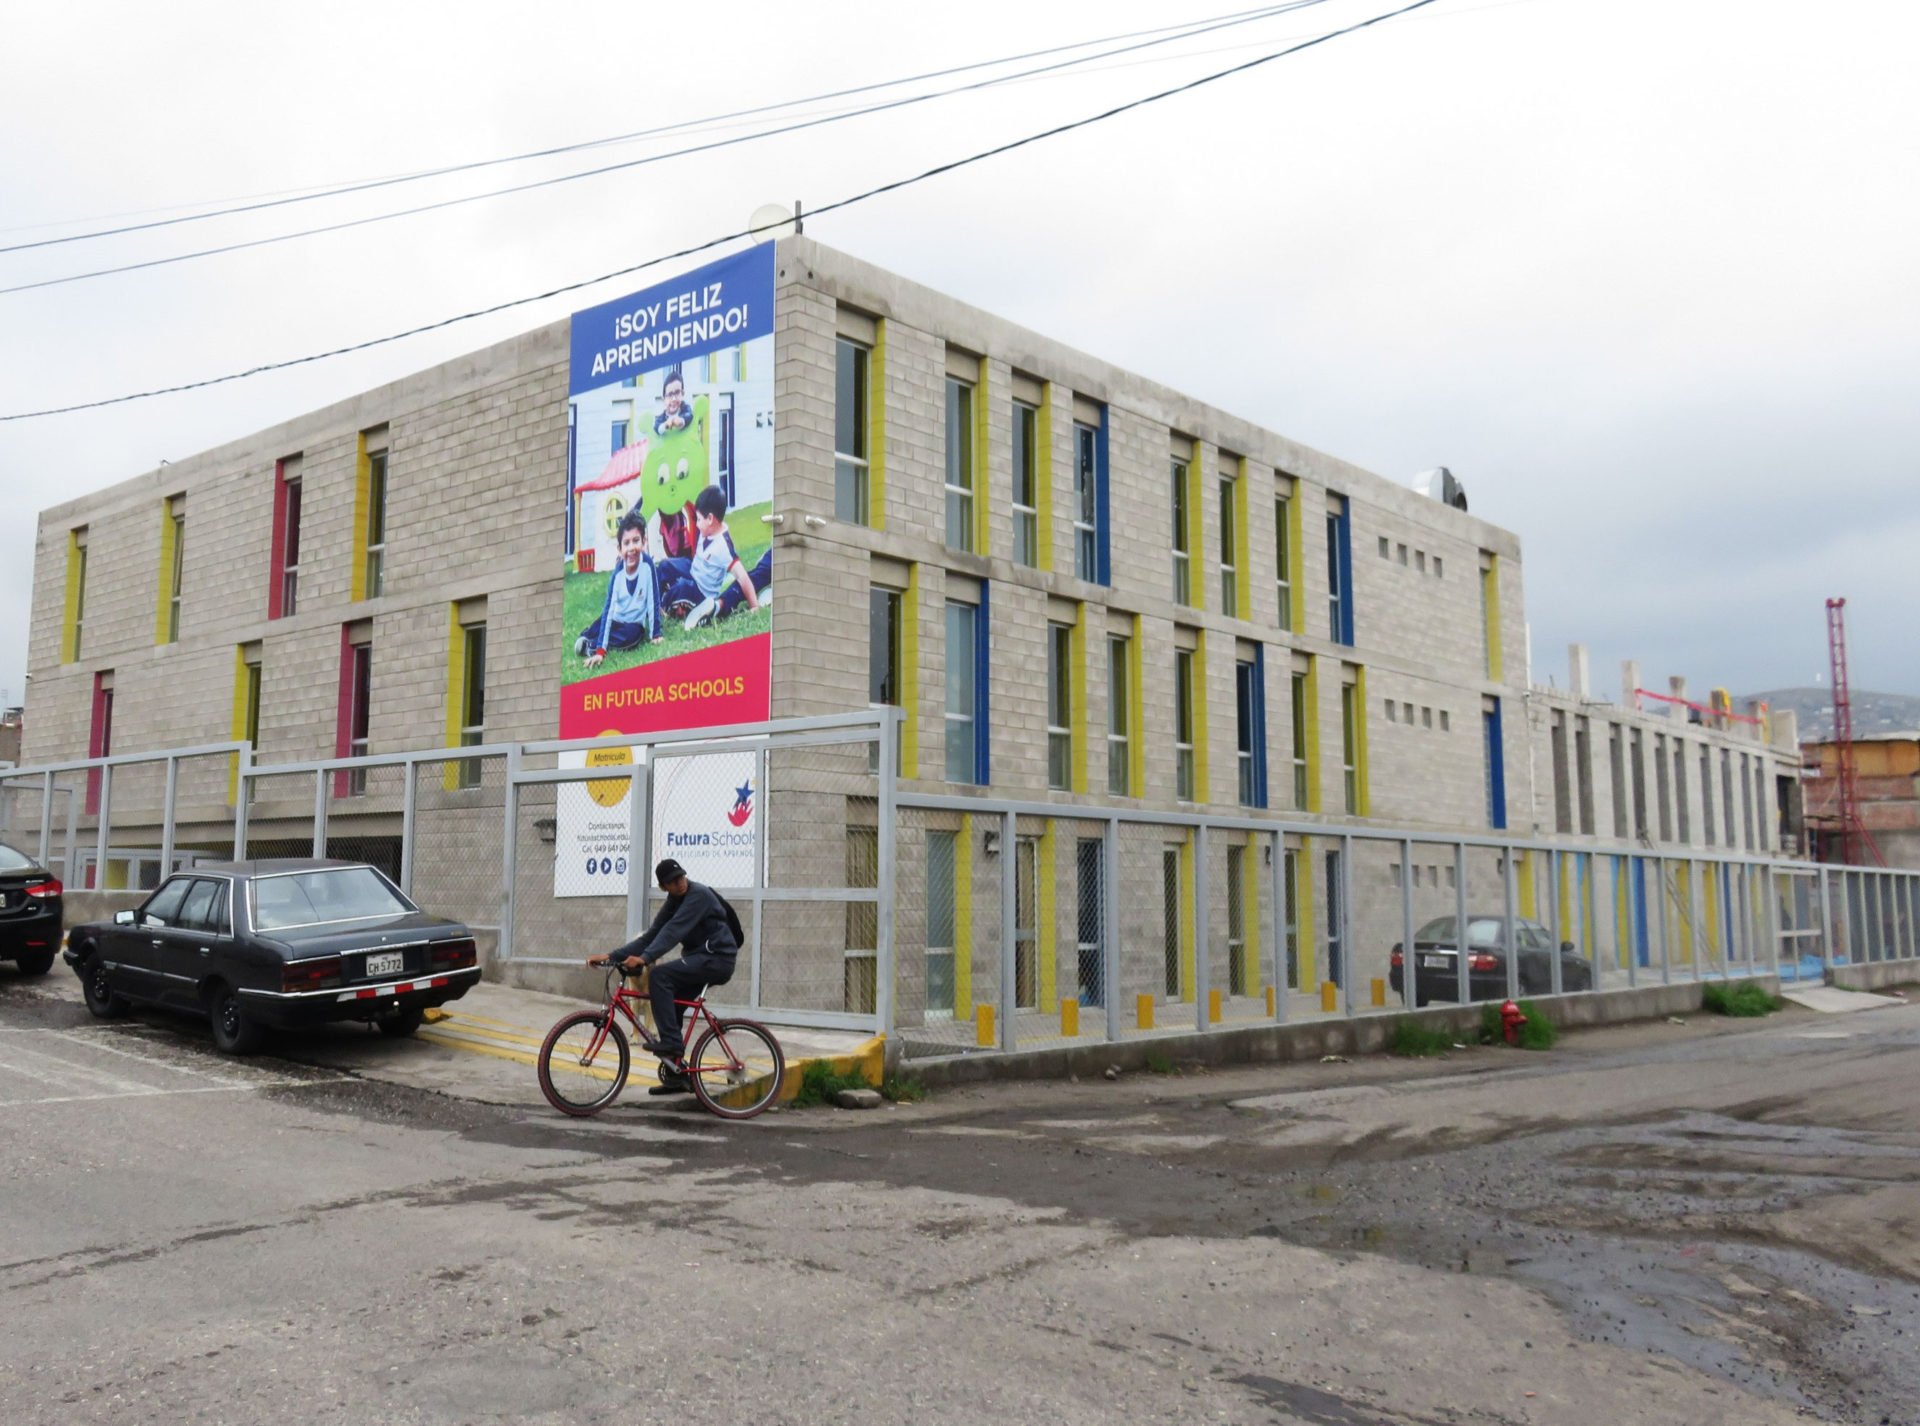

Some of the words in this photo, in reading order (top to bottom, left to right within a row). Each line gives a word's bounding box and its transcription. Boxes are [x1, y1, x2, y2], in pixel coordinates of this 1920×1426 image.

[615, 303, 661, 340] ¡SOY
[666, 282, 723, 322] FELIZ
[591, 304, 748, 377] APRENDIENDO!
[583, 694, 602, 712] EN
[606, 686, 665, 709] FUTURA
[668, 676, 745, 702] SCHOOLS
